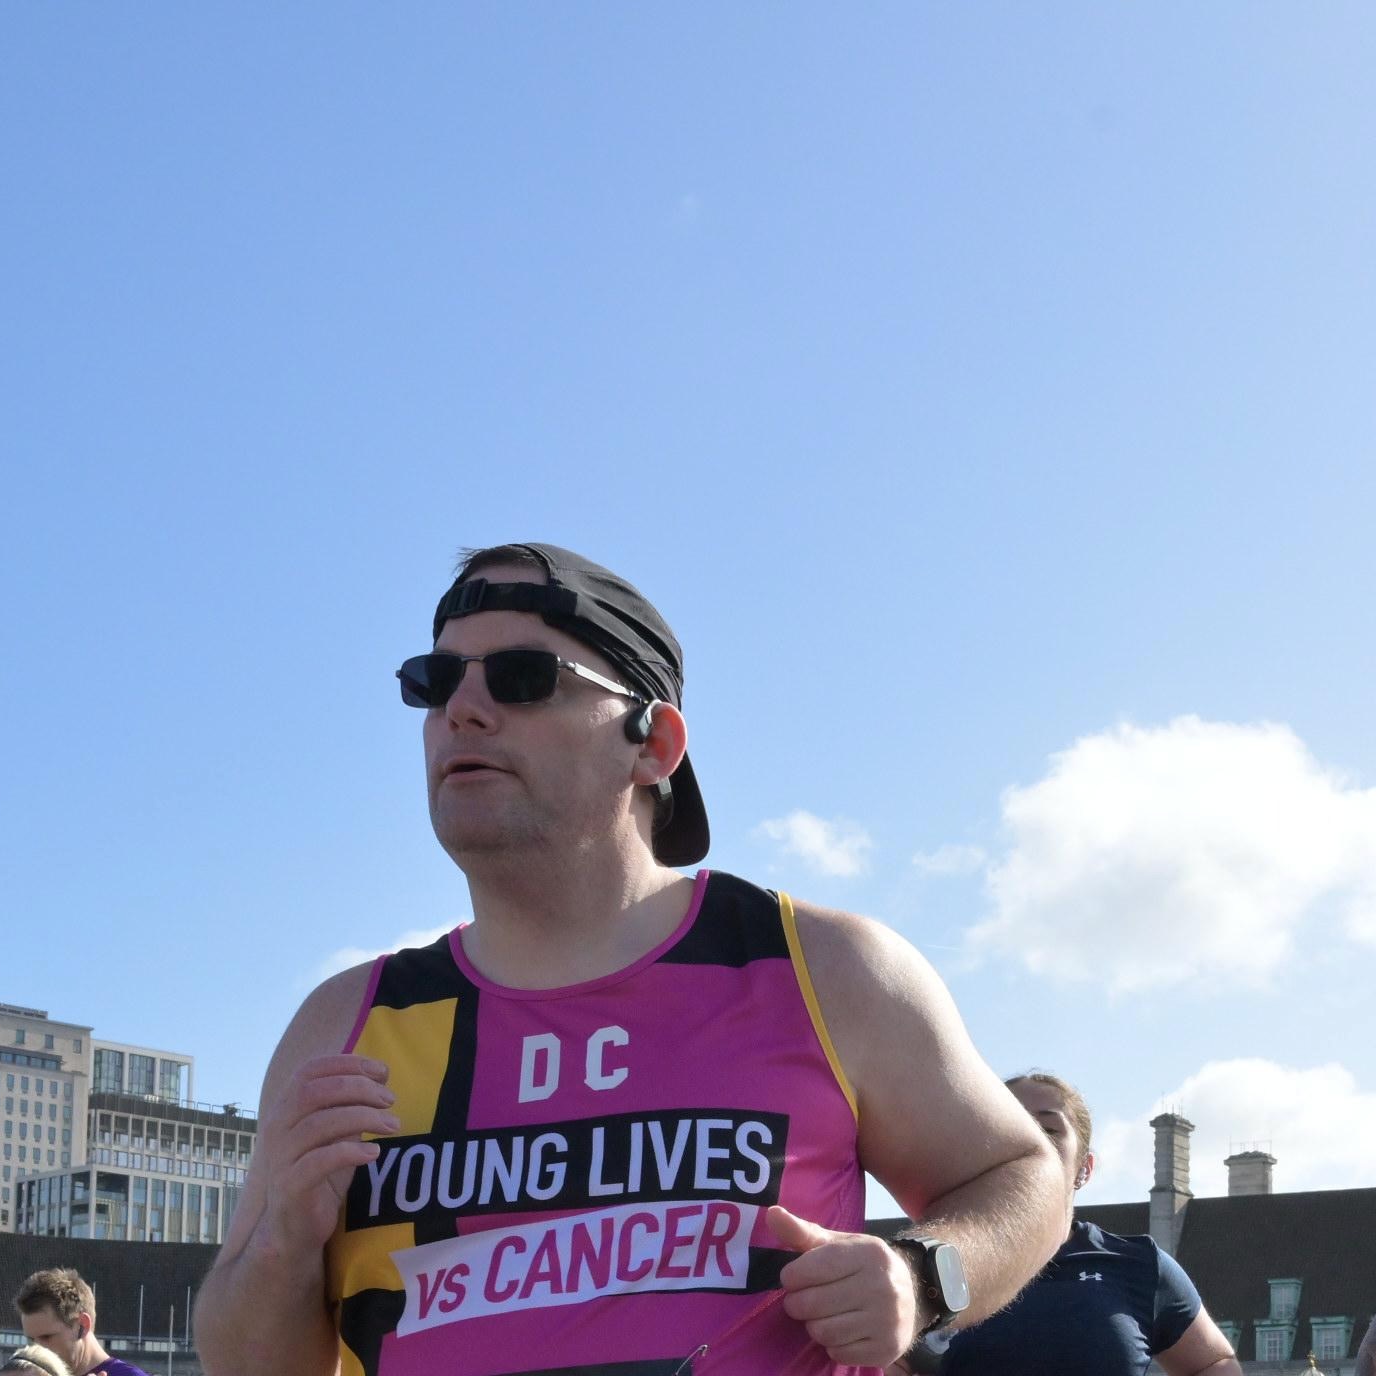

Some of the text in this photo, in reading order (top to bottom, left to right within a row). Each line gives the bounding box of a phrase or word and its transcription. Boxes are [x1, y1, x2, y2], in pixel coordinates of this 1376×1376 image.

[367, 1119, 773, 1217] YOUNG LIVES
[484, 1203, 741, 1303] CANCER
